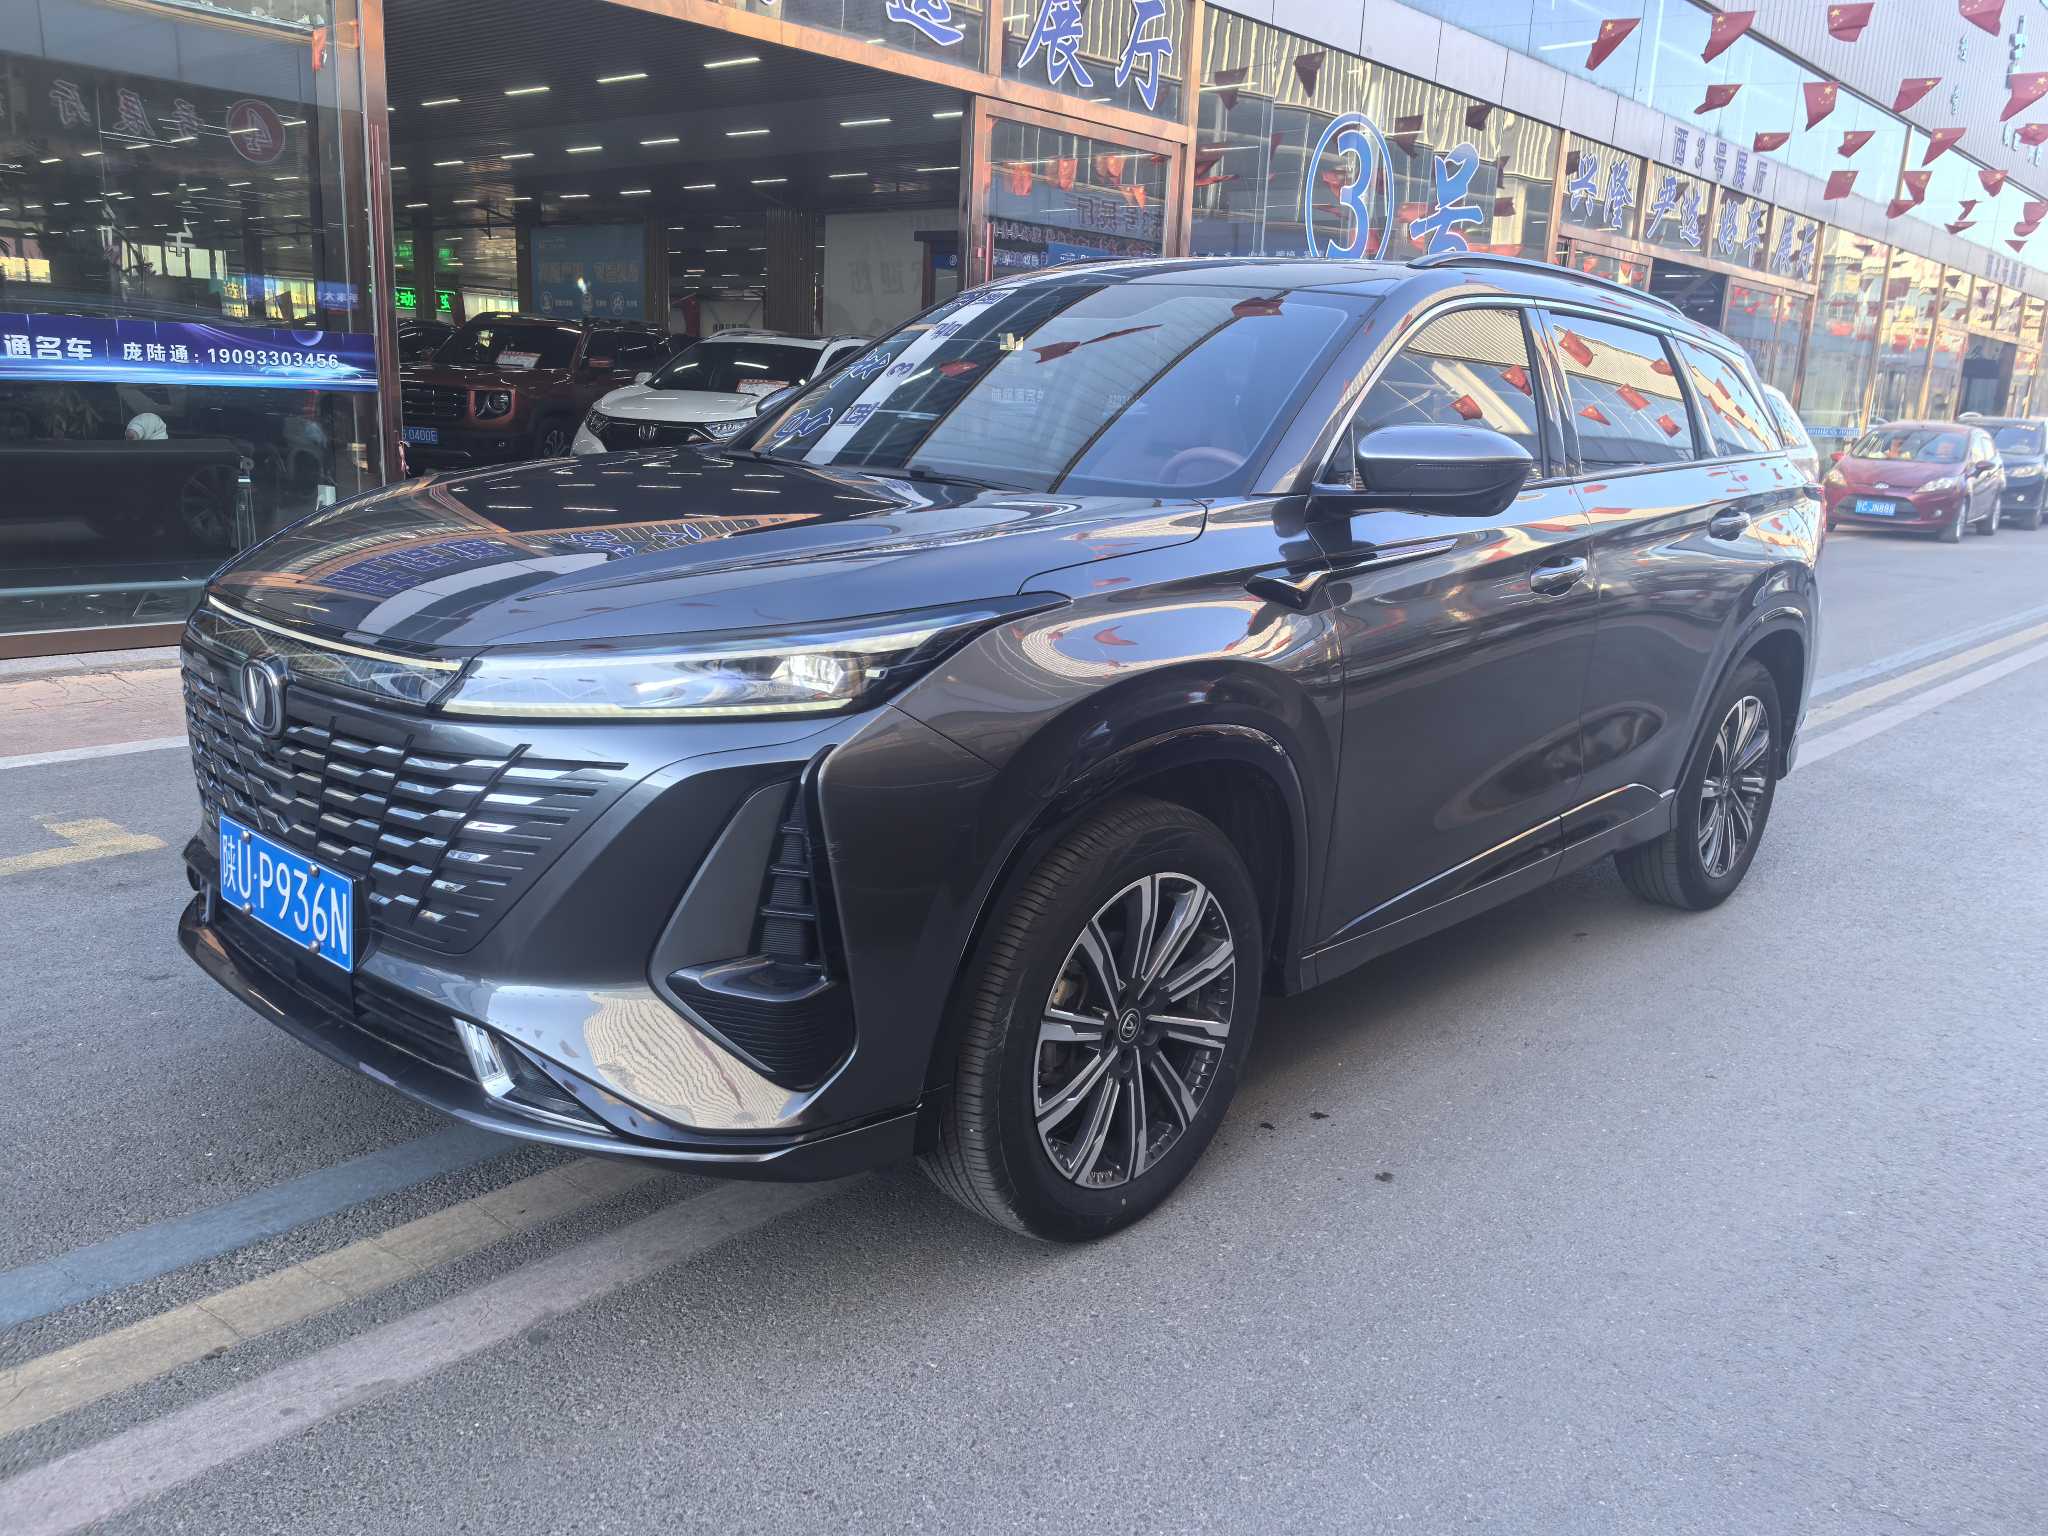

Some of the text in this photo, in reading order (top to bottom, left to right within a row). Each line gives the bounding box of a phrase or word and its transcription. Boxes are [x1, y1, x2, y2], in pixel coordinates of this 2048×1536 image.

[4, 333, 93, 360] 通名车
[208, 348, 339, 368] 19093303456
[222, 834, 348, 955] 陕U·P936N
